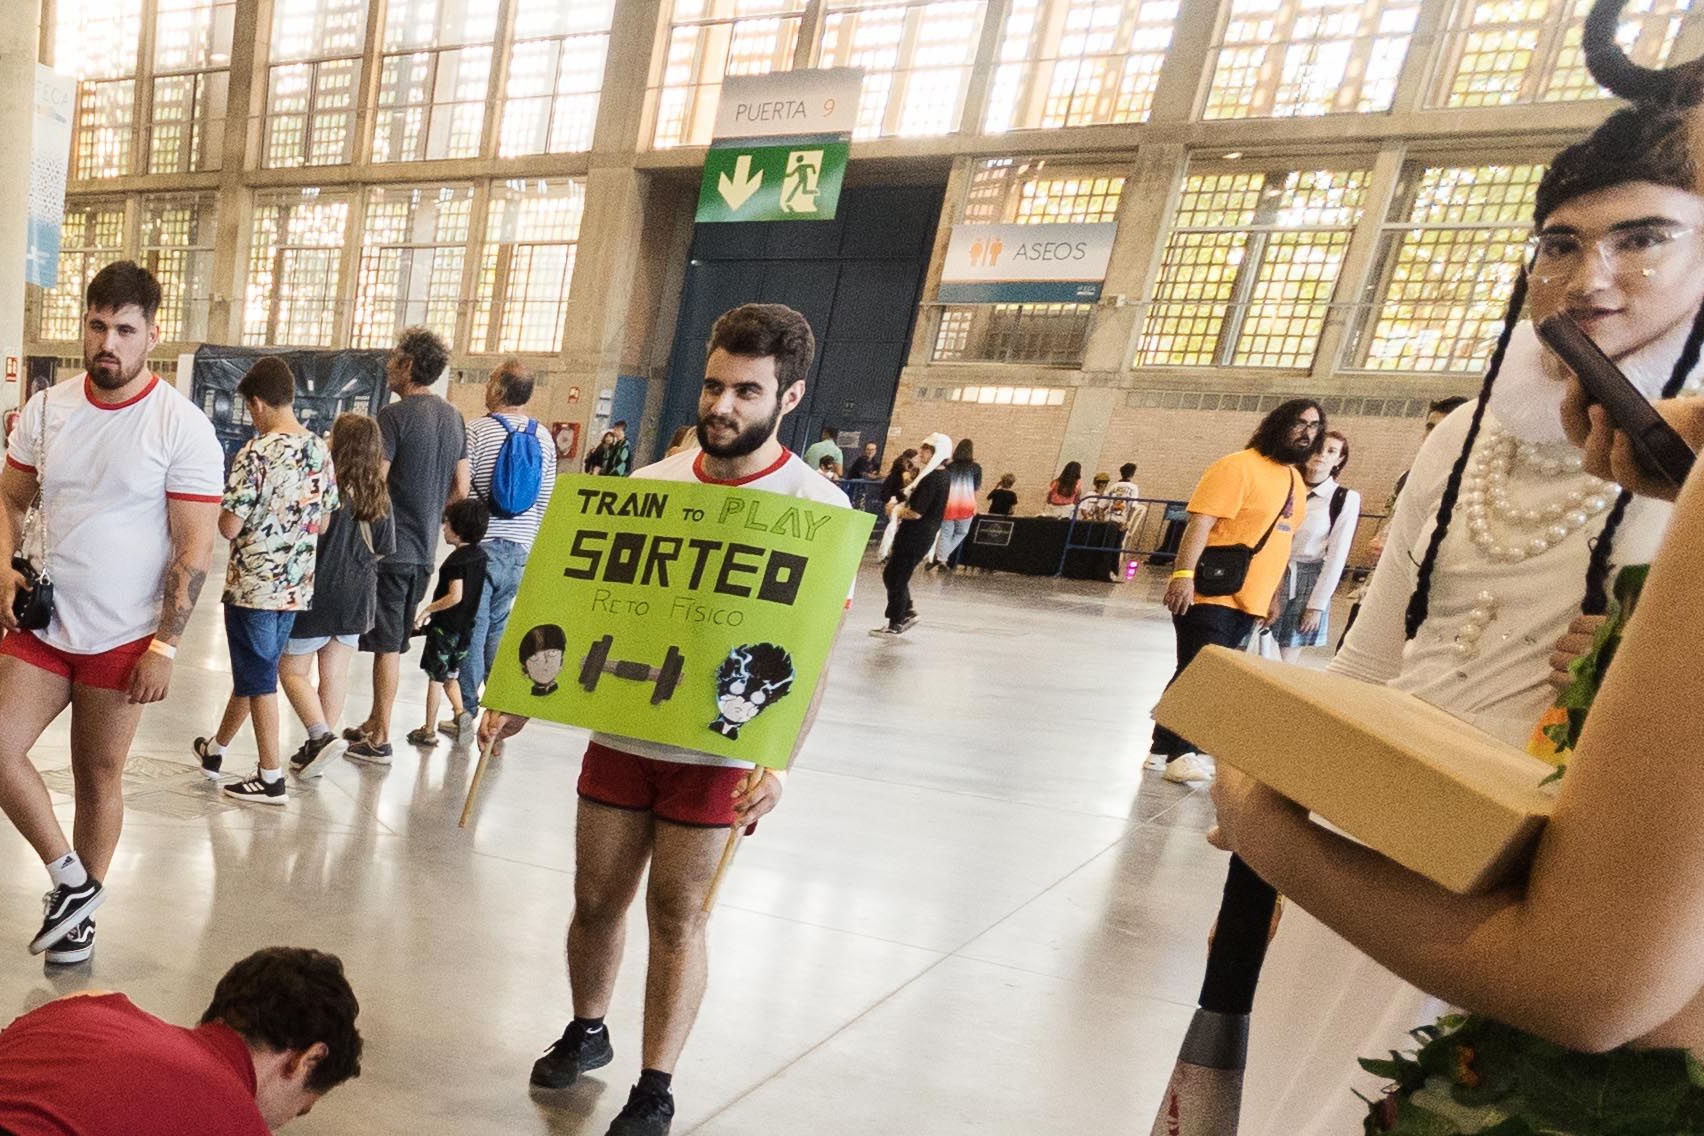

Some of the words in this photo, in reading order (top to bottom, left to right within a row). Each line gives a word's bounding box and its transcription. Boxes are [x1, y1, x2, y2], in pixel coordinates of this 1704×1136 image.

[735, 100, 807, 122] PUERTA
[823, 98, 836, 118] 9
[1012, 241, 1088, 261] ASEOS
[577, 488, 669, 520] TRAIN
[683, 507, 705, 523] TO
[717, 496, 832, 542] PLAY
[563, 529, 809, 606] SORTEO
[591, 589, 650, 617] RETO
